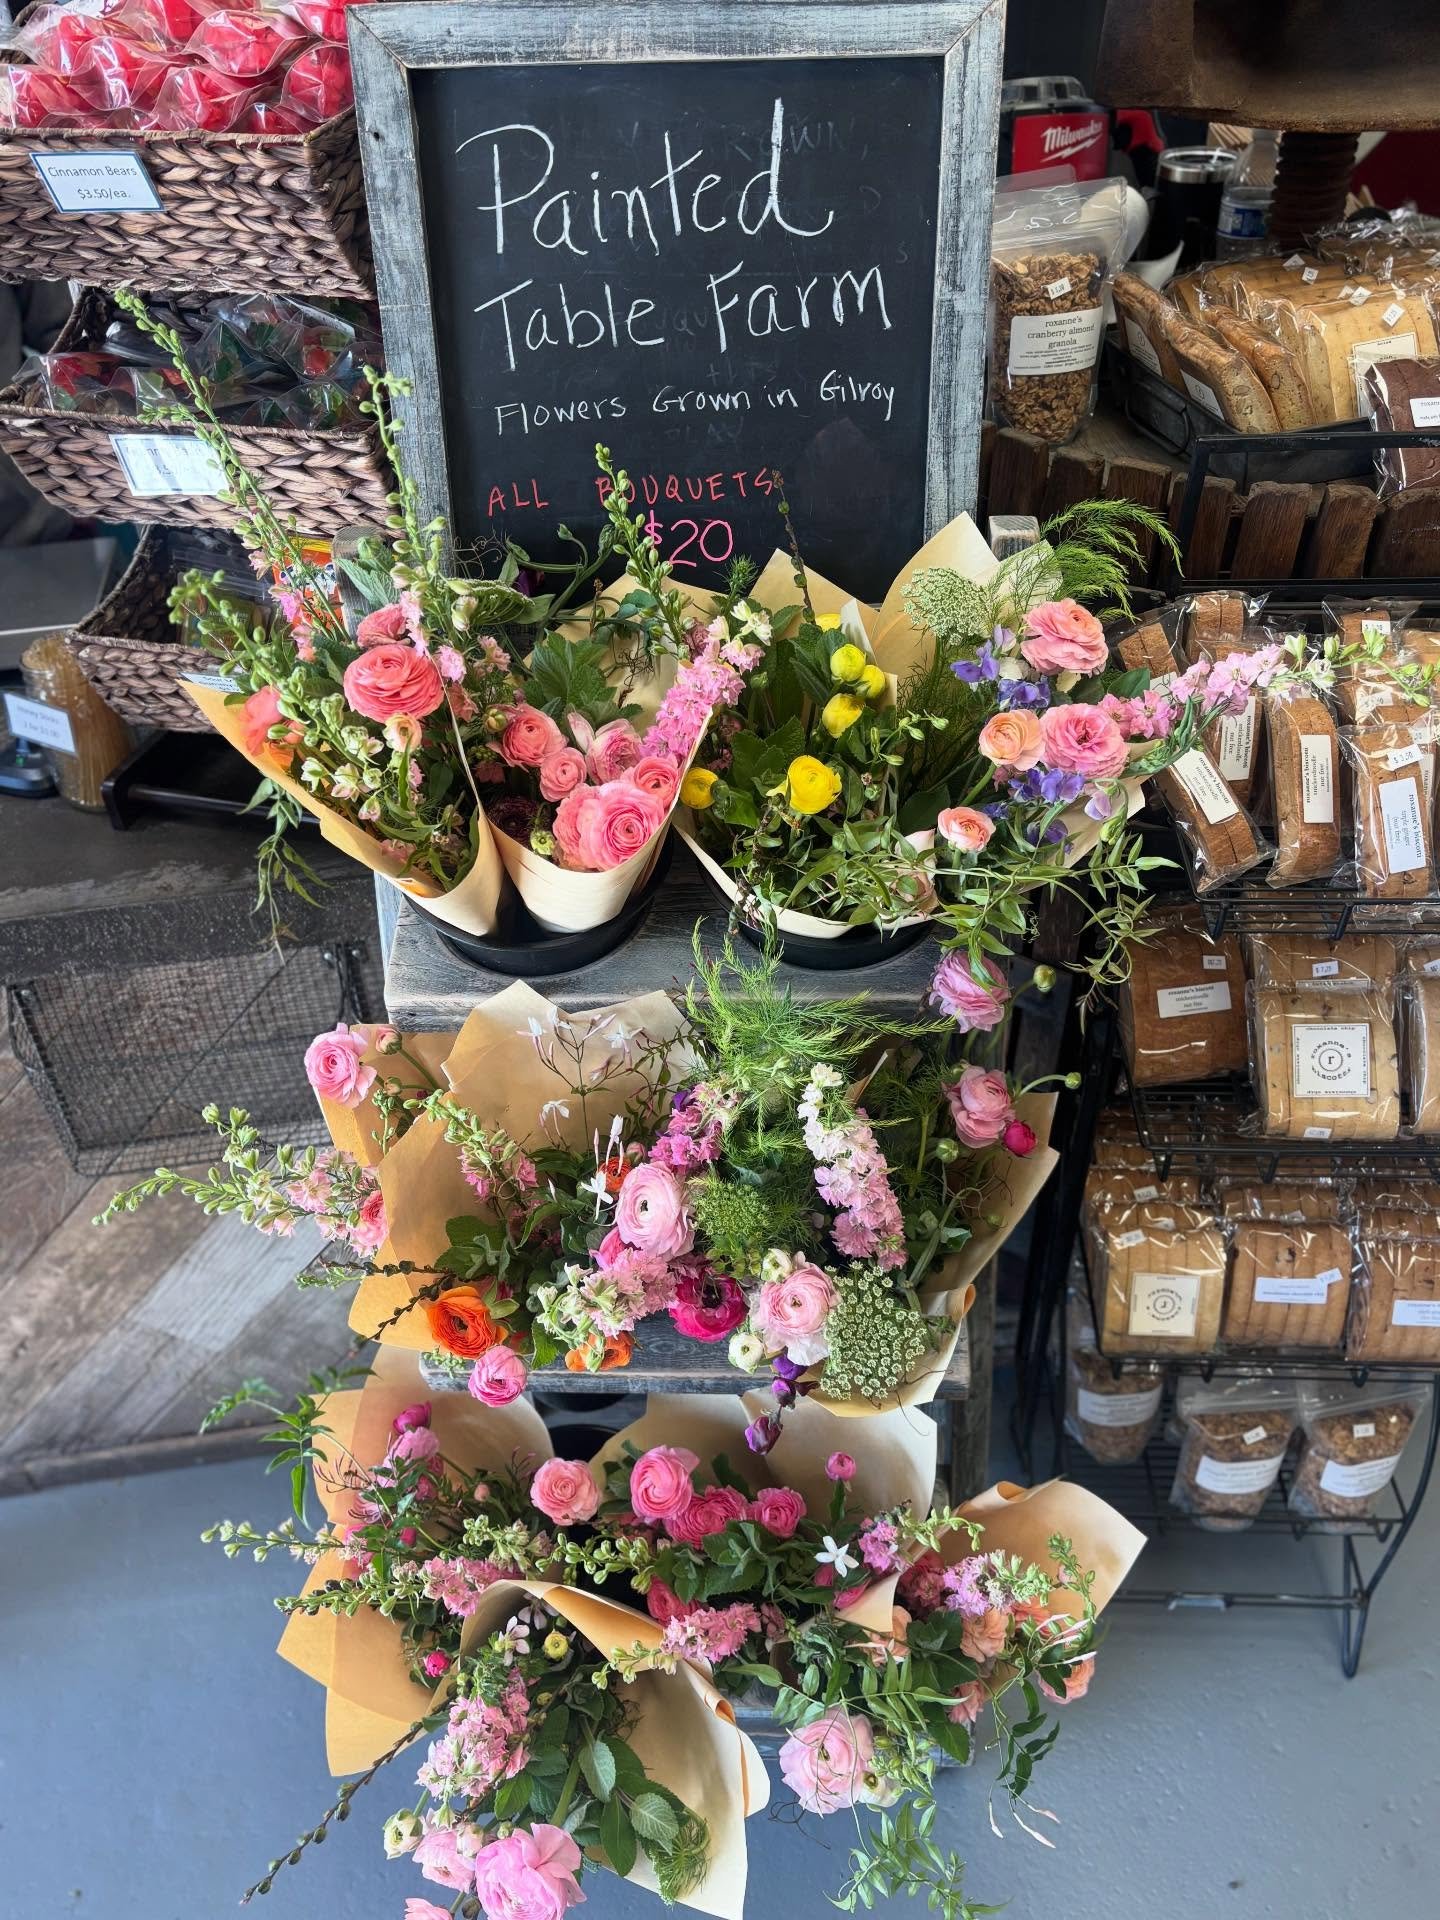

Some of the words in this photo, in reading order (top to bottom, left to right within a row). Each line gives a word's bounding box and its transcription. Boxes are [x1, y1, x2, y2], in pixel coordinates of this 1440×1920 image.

[47, 166, 104, 178] Cinnamon
[105, 165, 138, 177] Bears
[455, 97, 834, 256] Painted
[77, 188, 132, 200] $3.50/ea.
[474, 279, 667, 372] Table
[707, 261, 893, 354] Farm
[1027, 330, 1067, 339] cranberry
[1068, 324, 1095, 335] almond
[1045, 316, 1083, 327] roxanne's
[1048, 338, 1077, 349] granola
[496, 396, 627, 435] Flowers
[652, 385, 751, 415] Grown
[766, 386, 799, 410] in
[819, 369, 896, 421] Gilroy
[488, 479, 549, 516] ALL
[595, 467, 774, 507] BOUQUETS
[644, 510, 734, 567] $20
[1409, 794, 1420, 830] roxanne's
[1414, 830, 1423, 858] biscotti
